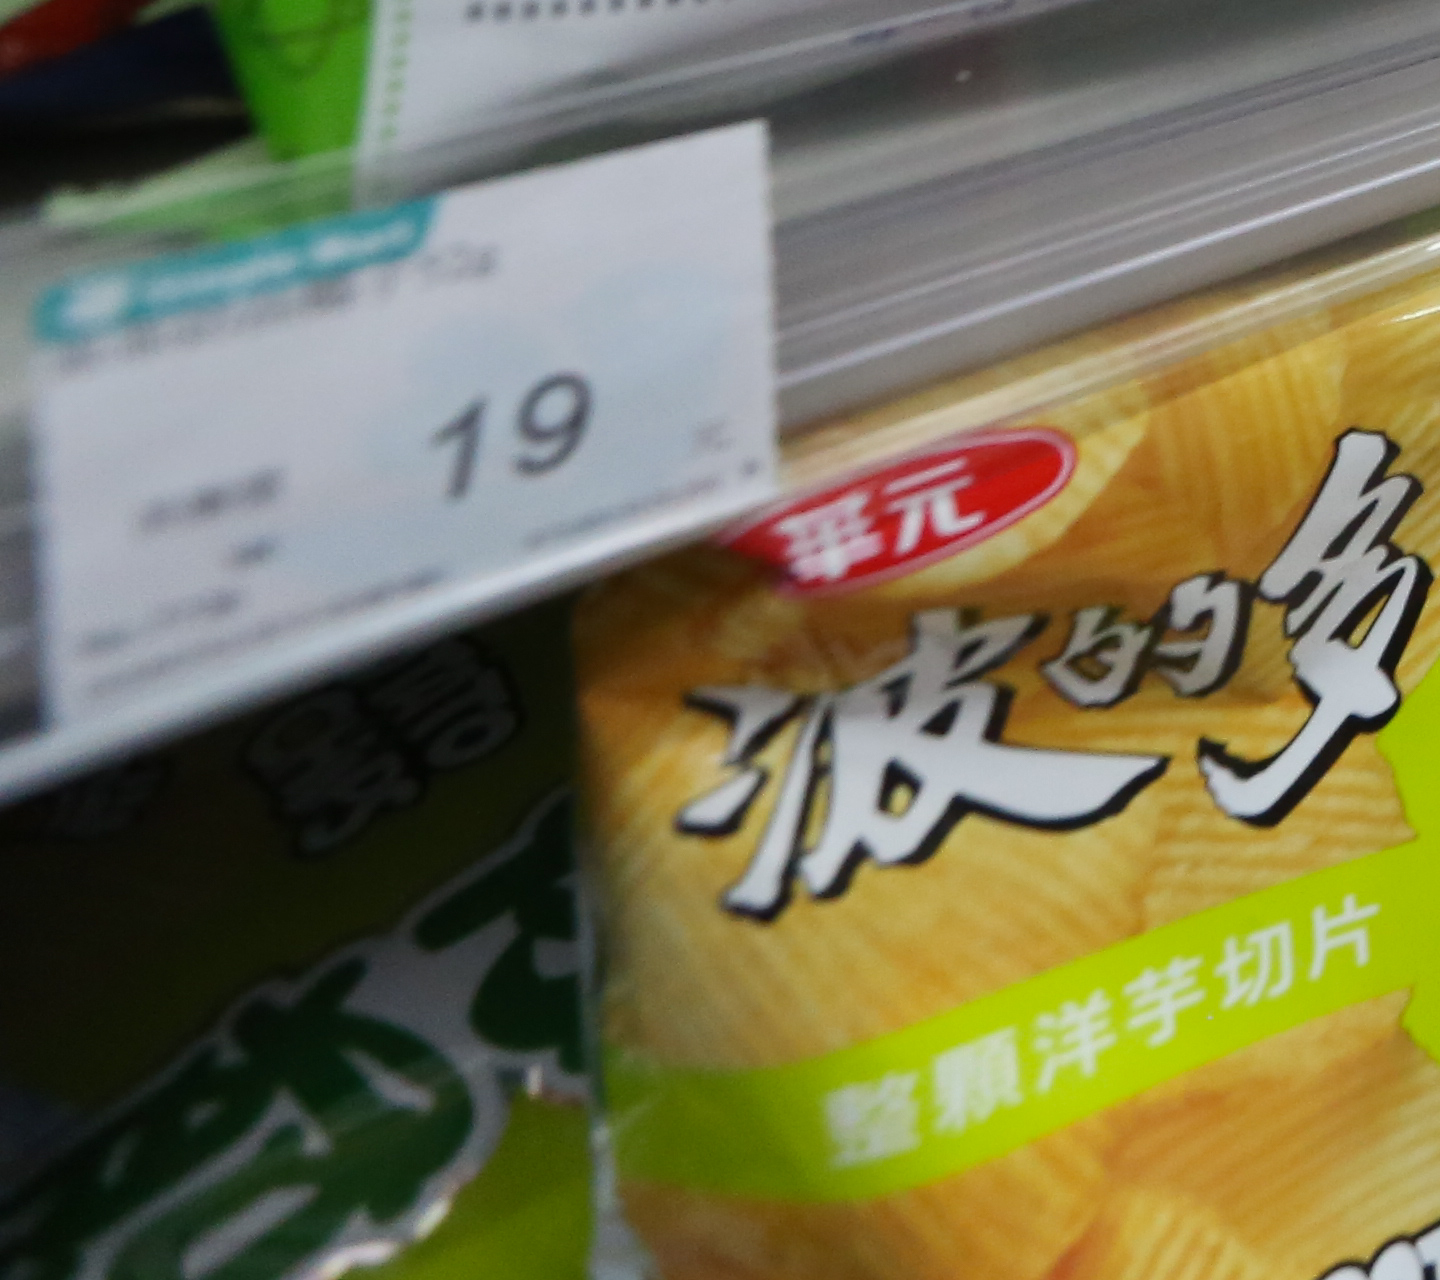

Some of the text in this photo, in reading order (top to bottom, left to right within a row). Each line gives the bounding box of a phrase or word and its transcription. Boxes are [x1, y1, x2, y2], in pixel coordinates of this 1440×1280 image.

[430, 369, 595, 505] 19
[779, 457, 986, 580] 華元
[672, 428, 1437, 923] 波的多
[822, 892, 1381, 1171] 整顆洋芋切片
